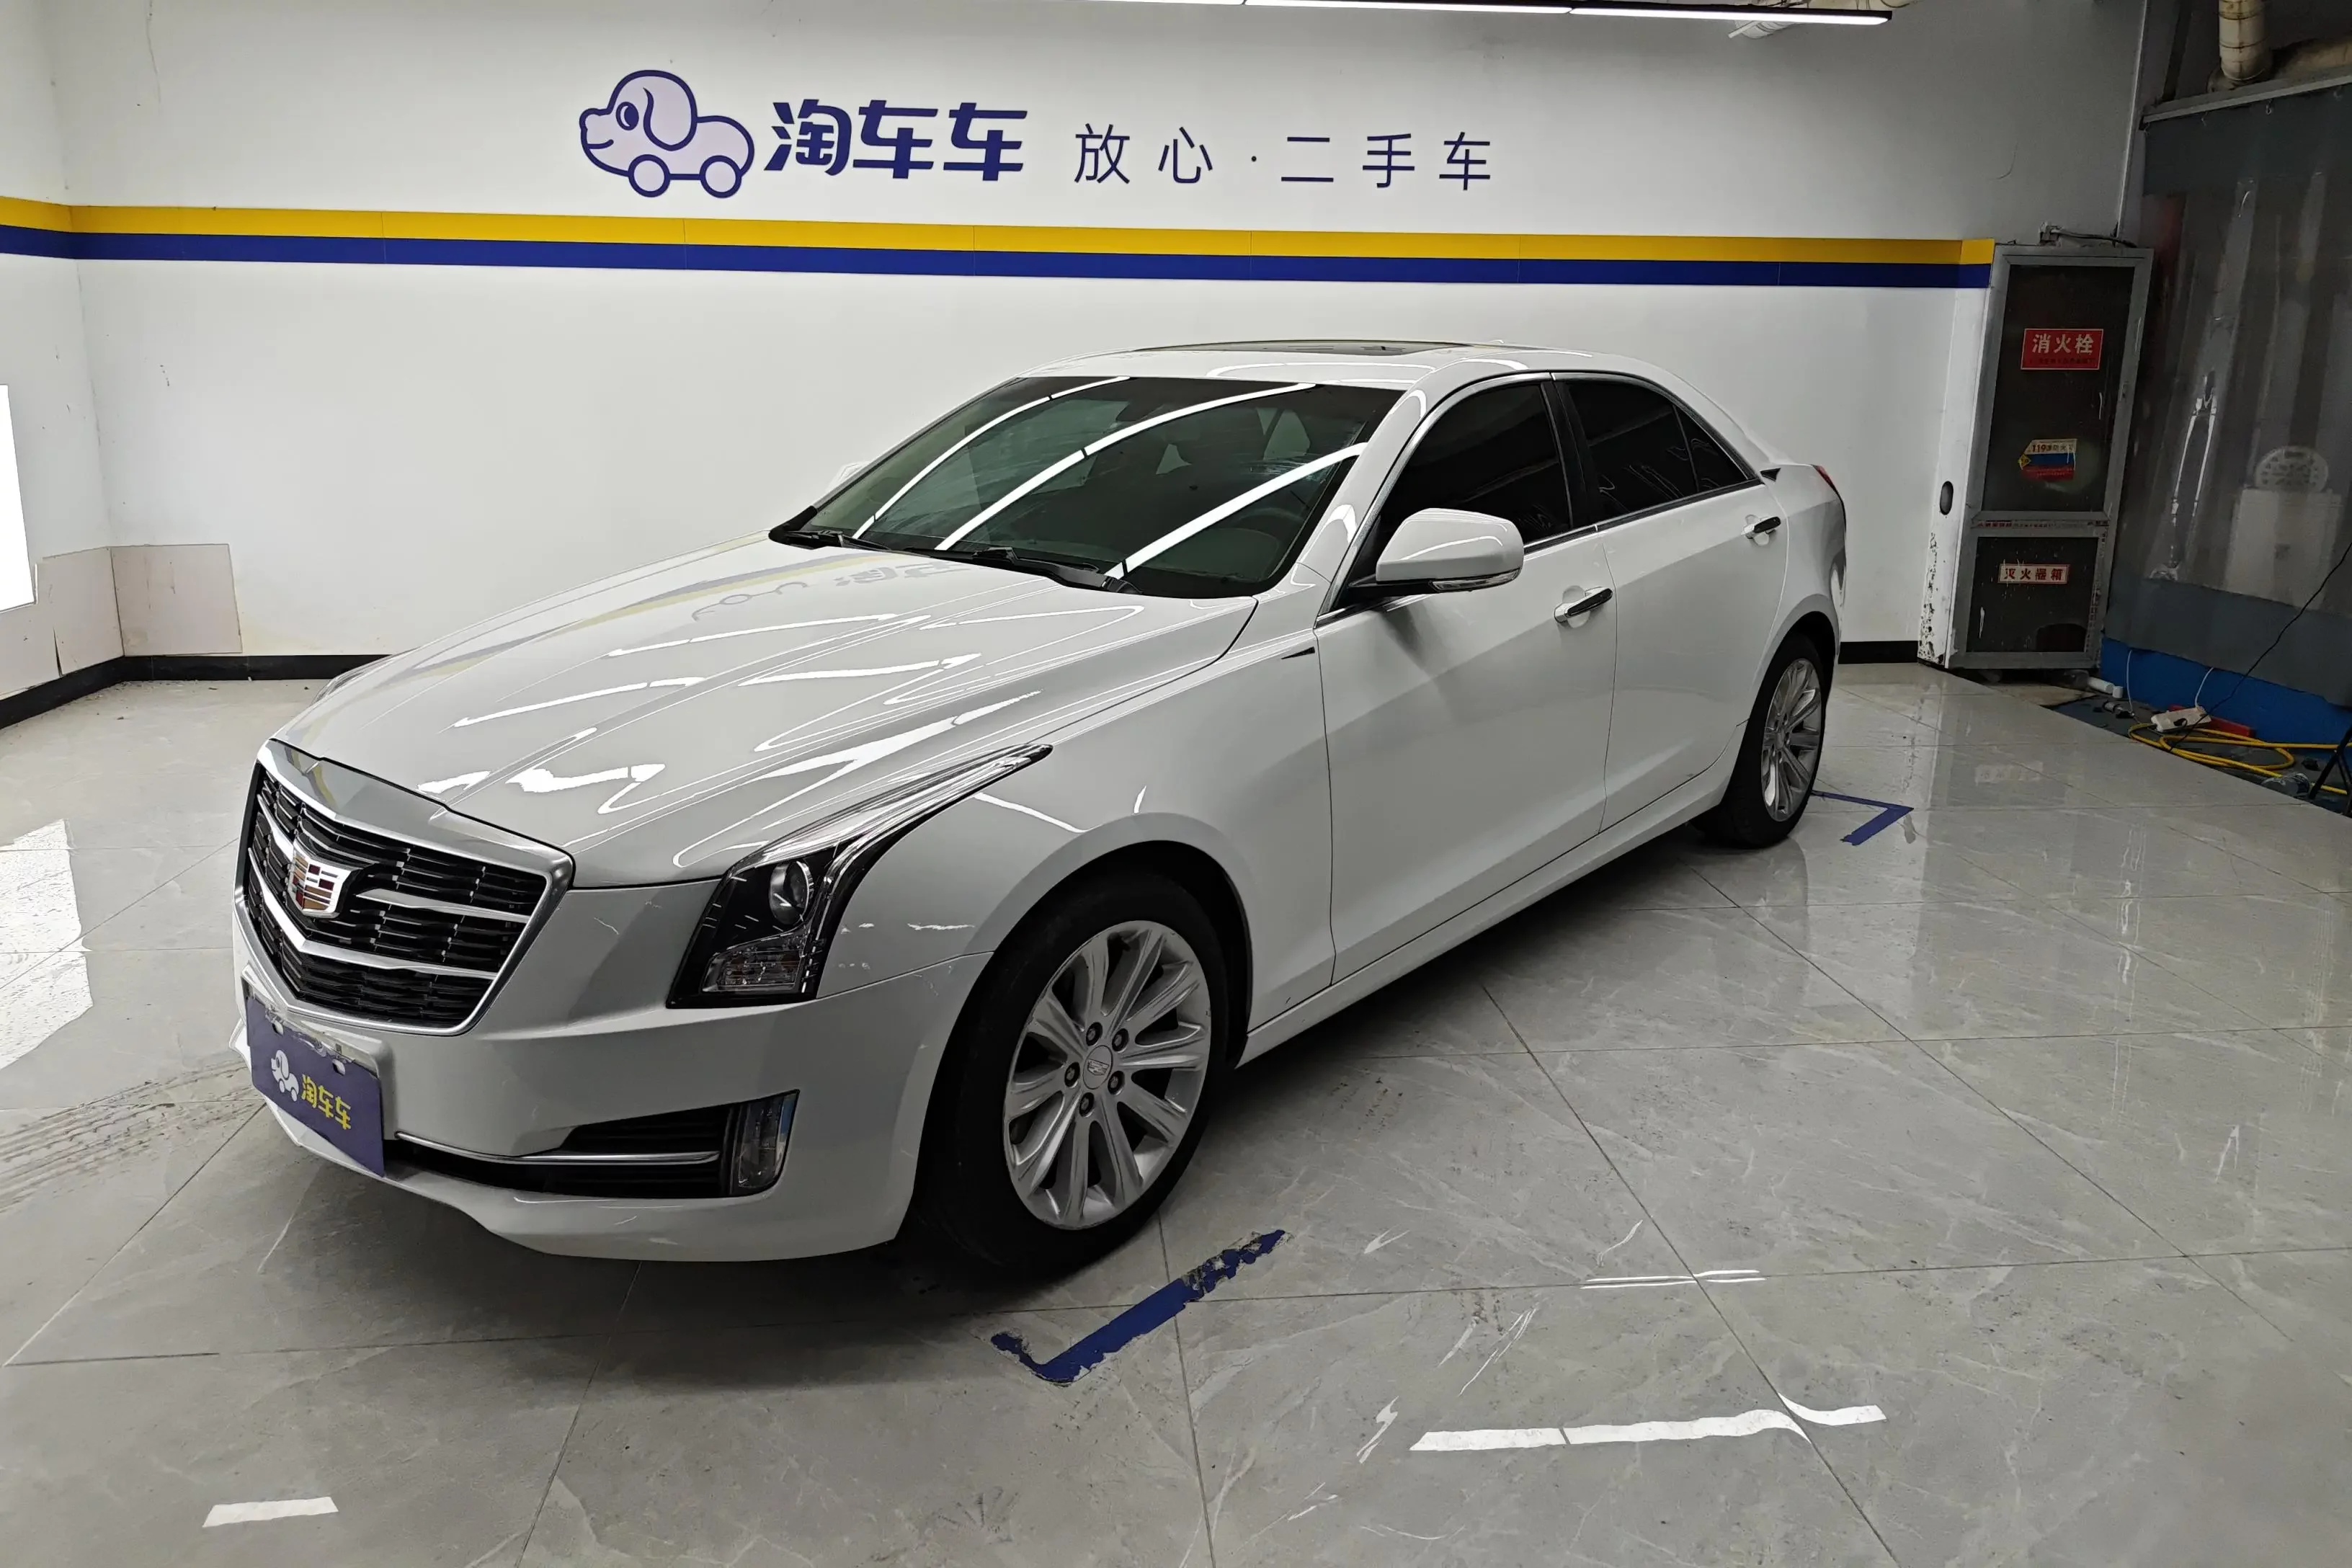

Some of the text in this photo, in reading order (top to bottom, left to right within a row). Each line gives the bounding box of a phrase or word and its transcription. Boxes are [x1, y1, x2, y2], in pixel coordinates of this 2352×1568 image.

[764, 99, 1028, 181] 淘车车
[2031, 333, 2094, 355] 消火栓
[2003, 567, 2064, 581] 灭火器箱
[301, 1074, 352, 1130] 淘车车
